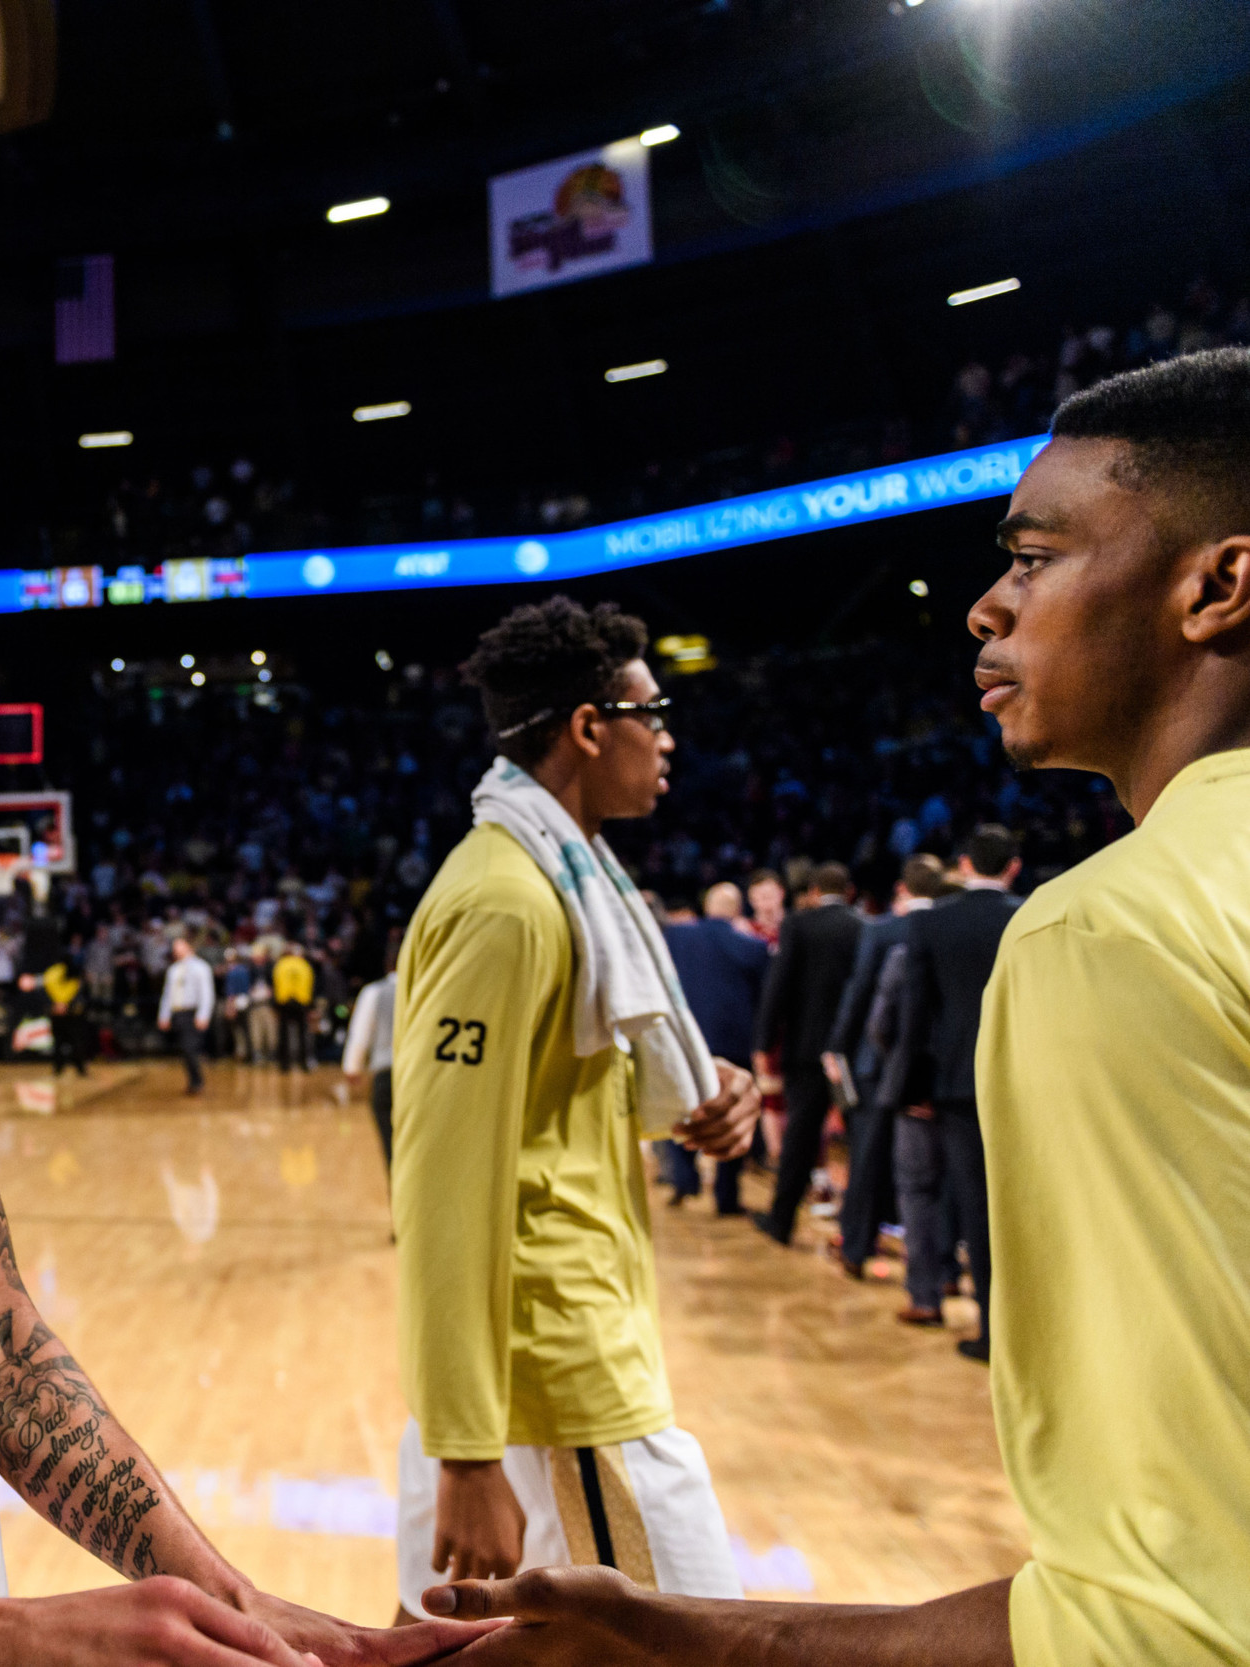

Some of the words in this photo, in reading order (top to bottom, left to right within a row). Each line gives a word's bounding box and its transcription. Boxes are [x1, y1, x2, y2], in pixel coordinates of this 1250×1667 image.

[803, 472, 909, 521] YOUR
[914, 442, 1051, 496] WORL
[435, 1017, 487, 1067] 23
